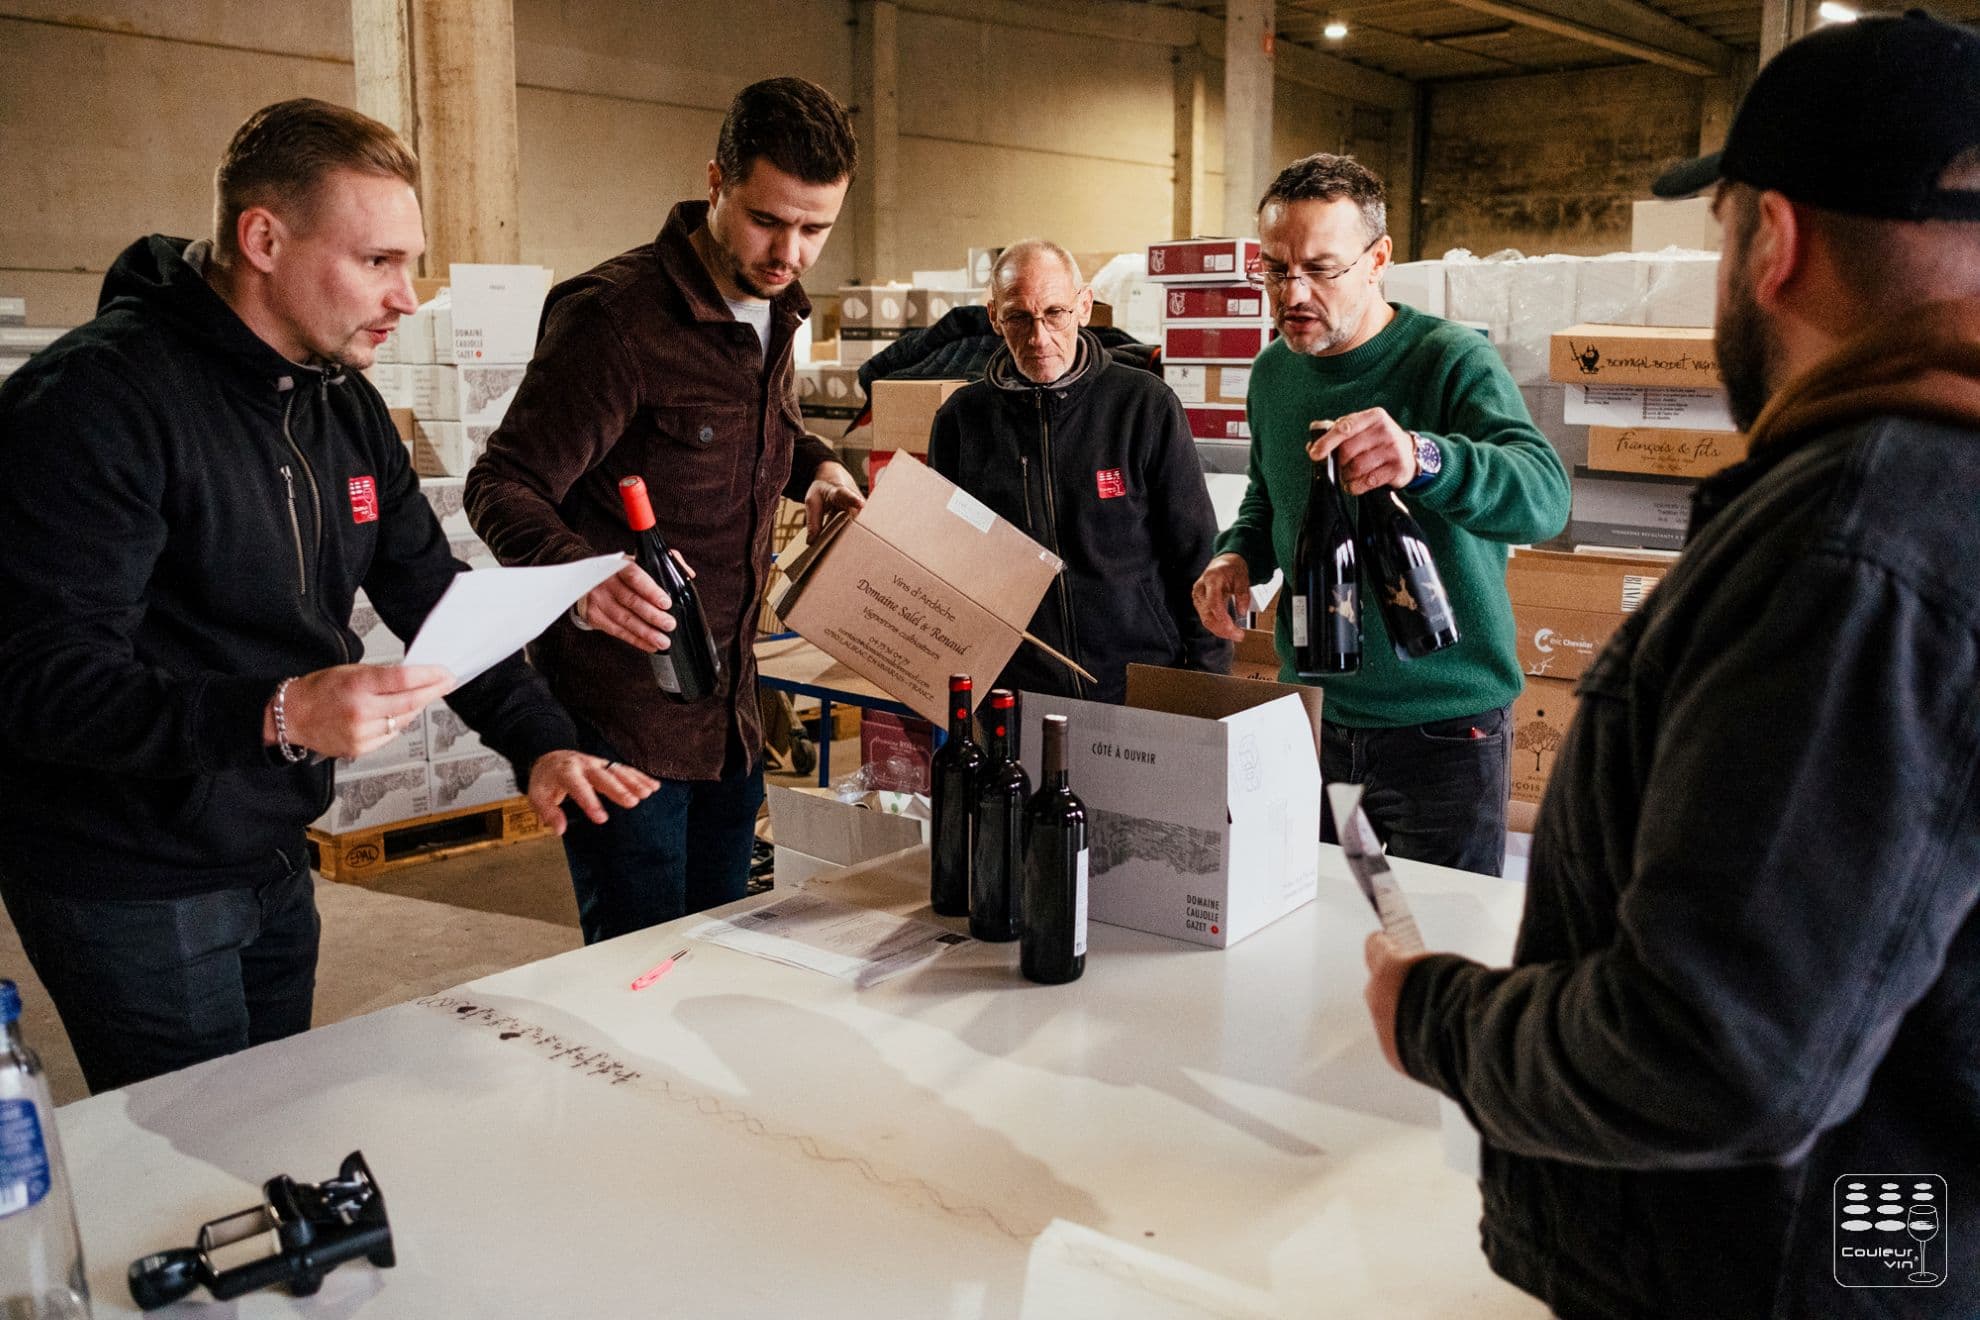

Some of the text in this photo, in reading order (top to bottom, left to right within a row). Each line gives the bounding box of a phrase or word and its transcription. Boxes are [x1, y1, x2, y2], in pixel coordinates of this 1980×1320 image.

[893, 574, 910, 592] Vins
[857, 579, 899, 612] Domaine
[930, 627, 972, 656] Renaud
[907, 681, 935, 701] FRANCE
[1092, 742, 1156, 764] CÔTÉ À OUVRIR
[1187, 894, 1220, 910] DOMAINE
[1186, 906, 1219, 922] CAUJOLLE
[1186, 919, 1207, 932] GAZET
